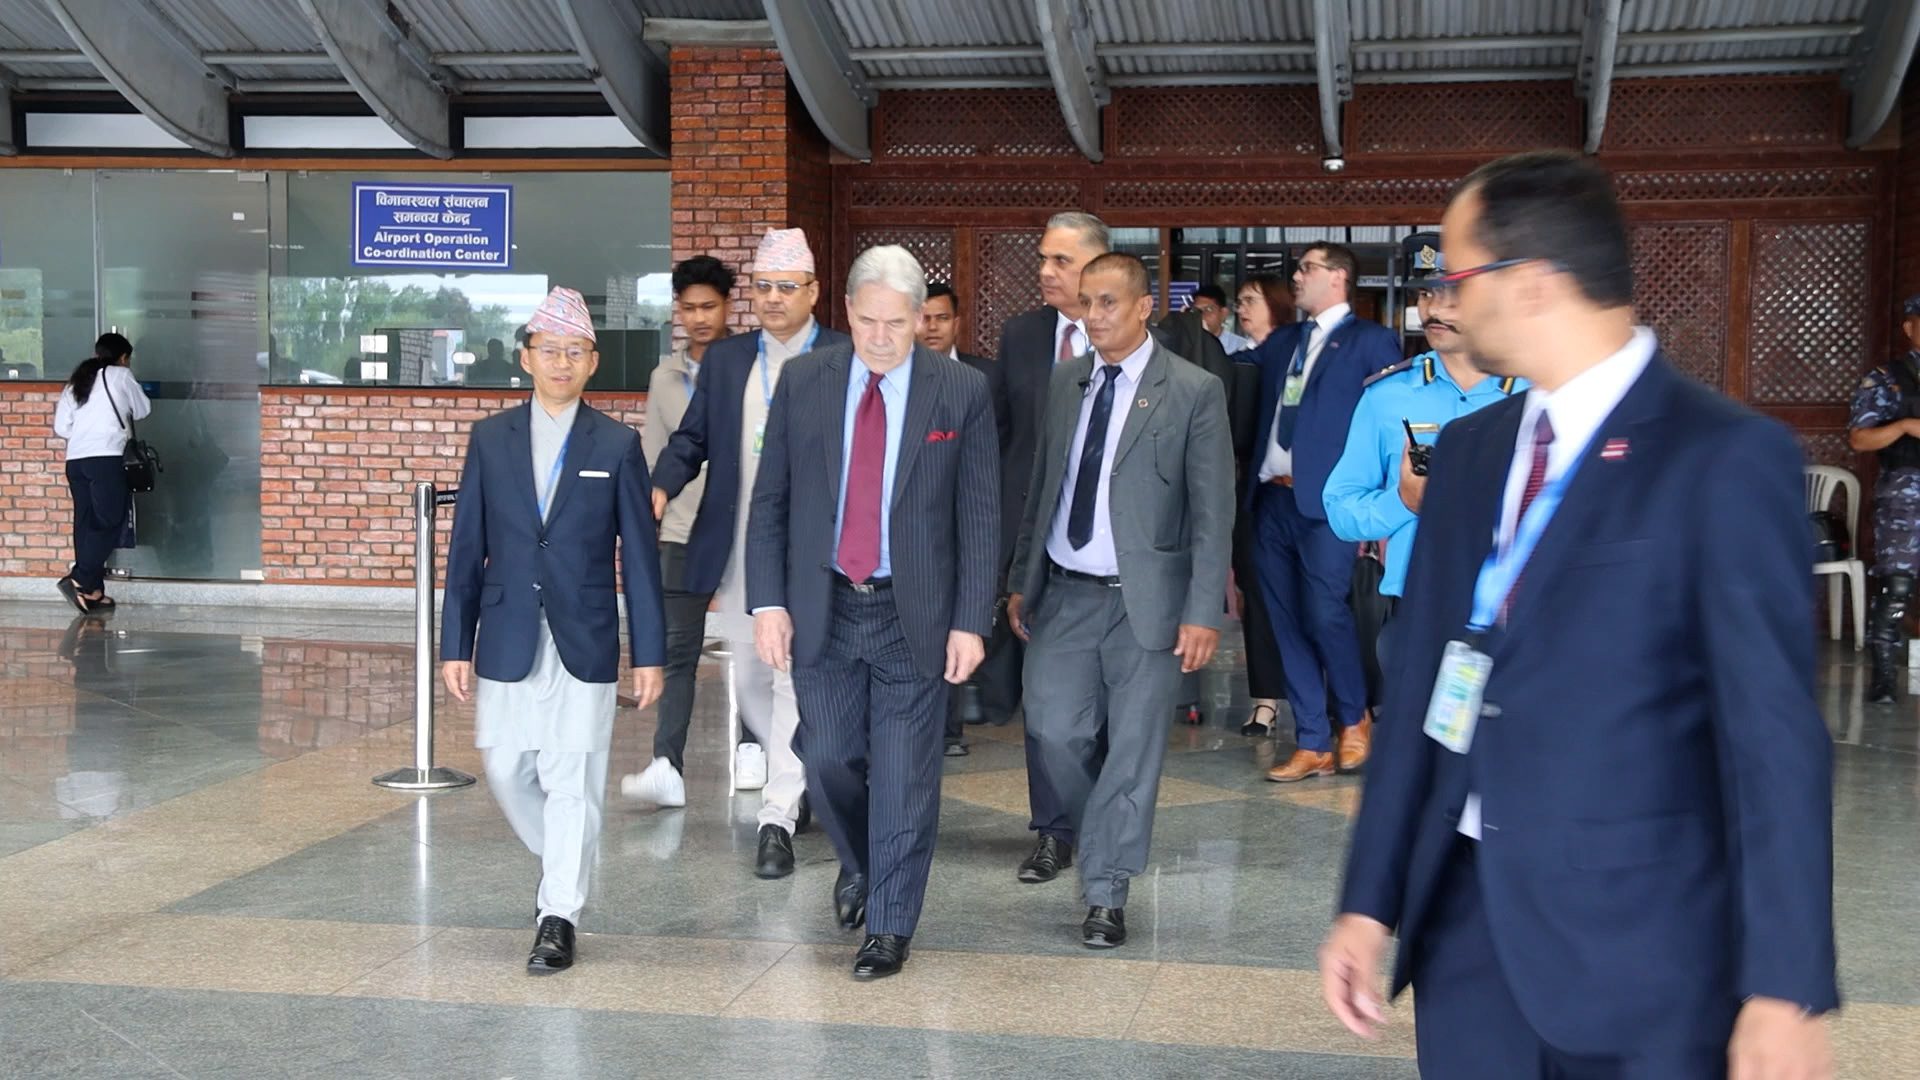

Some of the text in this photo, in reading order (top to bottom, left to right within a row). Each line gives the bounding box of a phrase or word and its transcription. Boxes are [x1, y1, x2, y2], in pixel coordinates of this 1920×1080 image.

[375, 191, 489, 208] विमानस्थल संचालन
[393, 210, 471, 226] समन्वय केन्द्र
[374, 231, 489, 246] Airport Operation
[363, 246, 500, 261] Co-ordination Center
